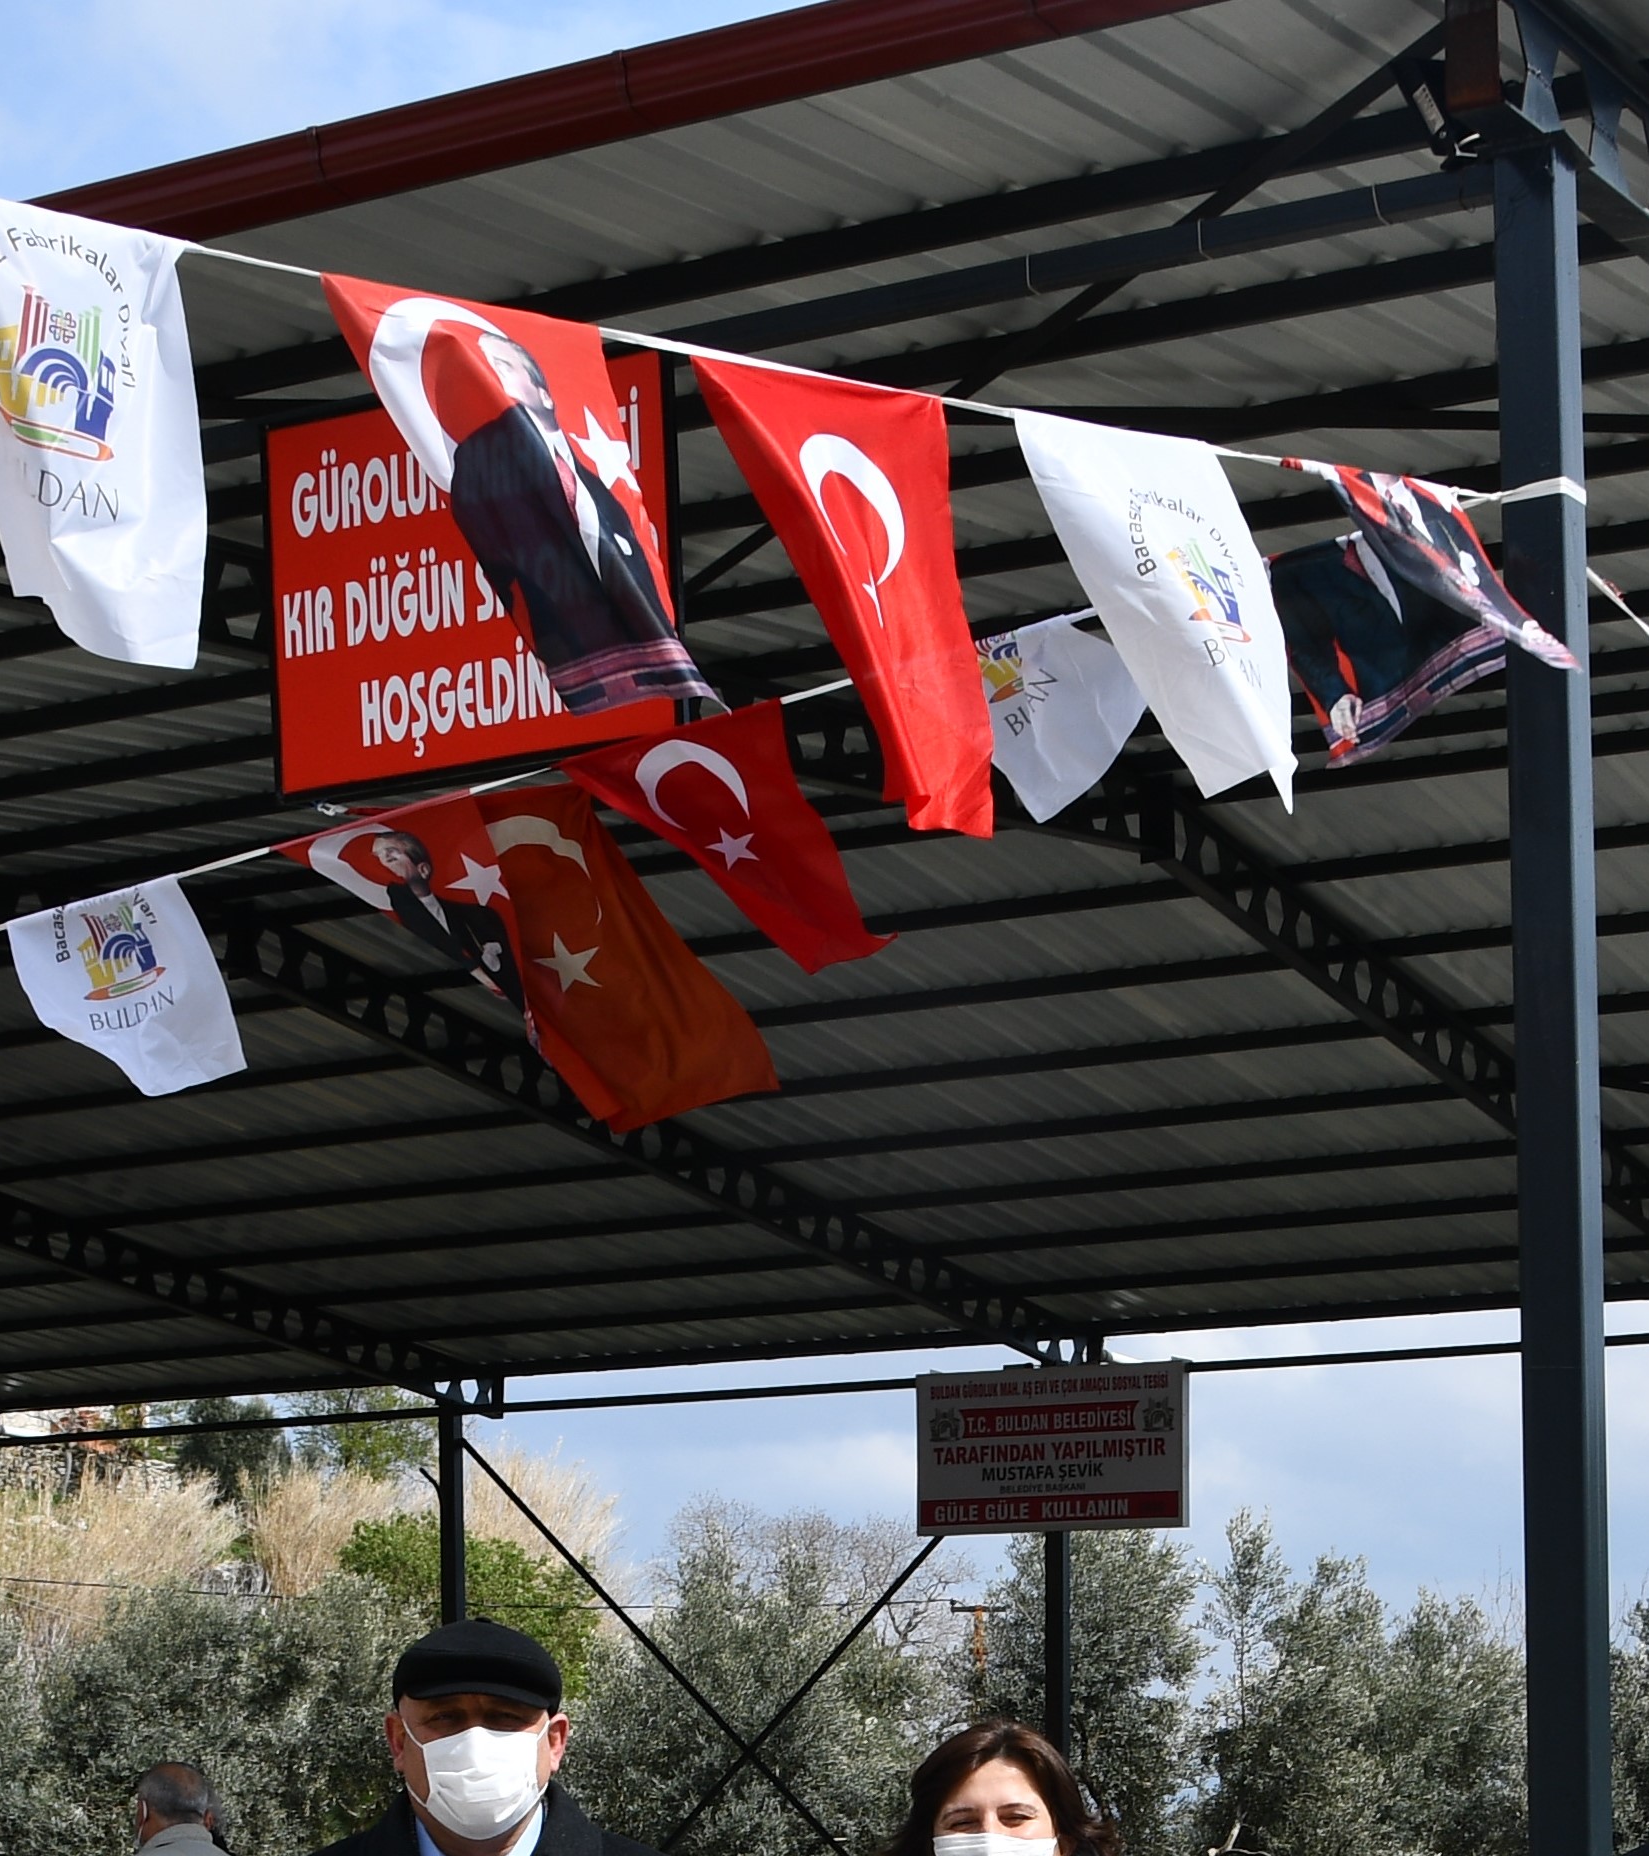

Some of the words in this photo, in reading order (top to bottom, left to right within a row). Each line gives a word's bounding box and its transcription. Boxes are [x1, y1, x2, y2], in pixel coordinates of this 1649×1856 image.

[7, 227, 124, 295] Fabrikalar
[291, 448, 447, 538] GÜROLU
[282, 584, 335, 659] KIR
[345, 546, 465, 647] DÜĞÜN
[967, 1416, 991, 1433] T.C.
[995, 1413, 1048, 1432] BULDAN
[1053, 1406, 1131, 1429] BELEDİYESİ
[933, 1443, 1045, 1466] TARAFINDAN
[1051, 1437, 1166, 1462] YAPILMIŞTIR
[982, 1464, 1054, 1482] MUSTAFA
[1058, 1459, 1104, 1481] ŞEVİK
[1046, 1482, 1086, 1494] BAŞKANI
[935, 1502, 979, 1523] GÜLE
[985, 1499, 1030, 1520] GÜLE
[1041, 1499, 1129, 1519] KULLANIN
